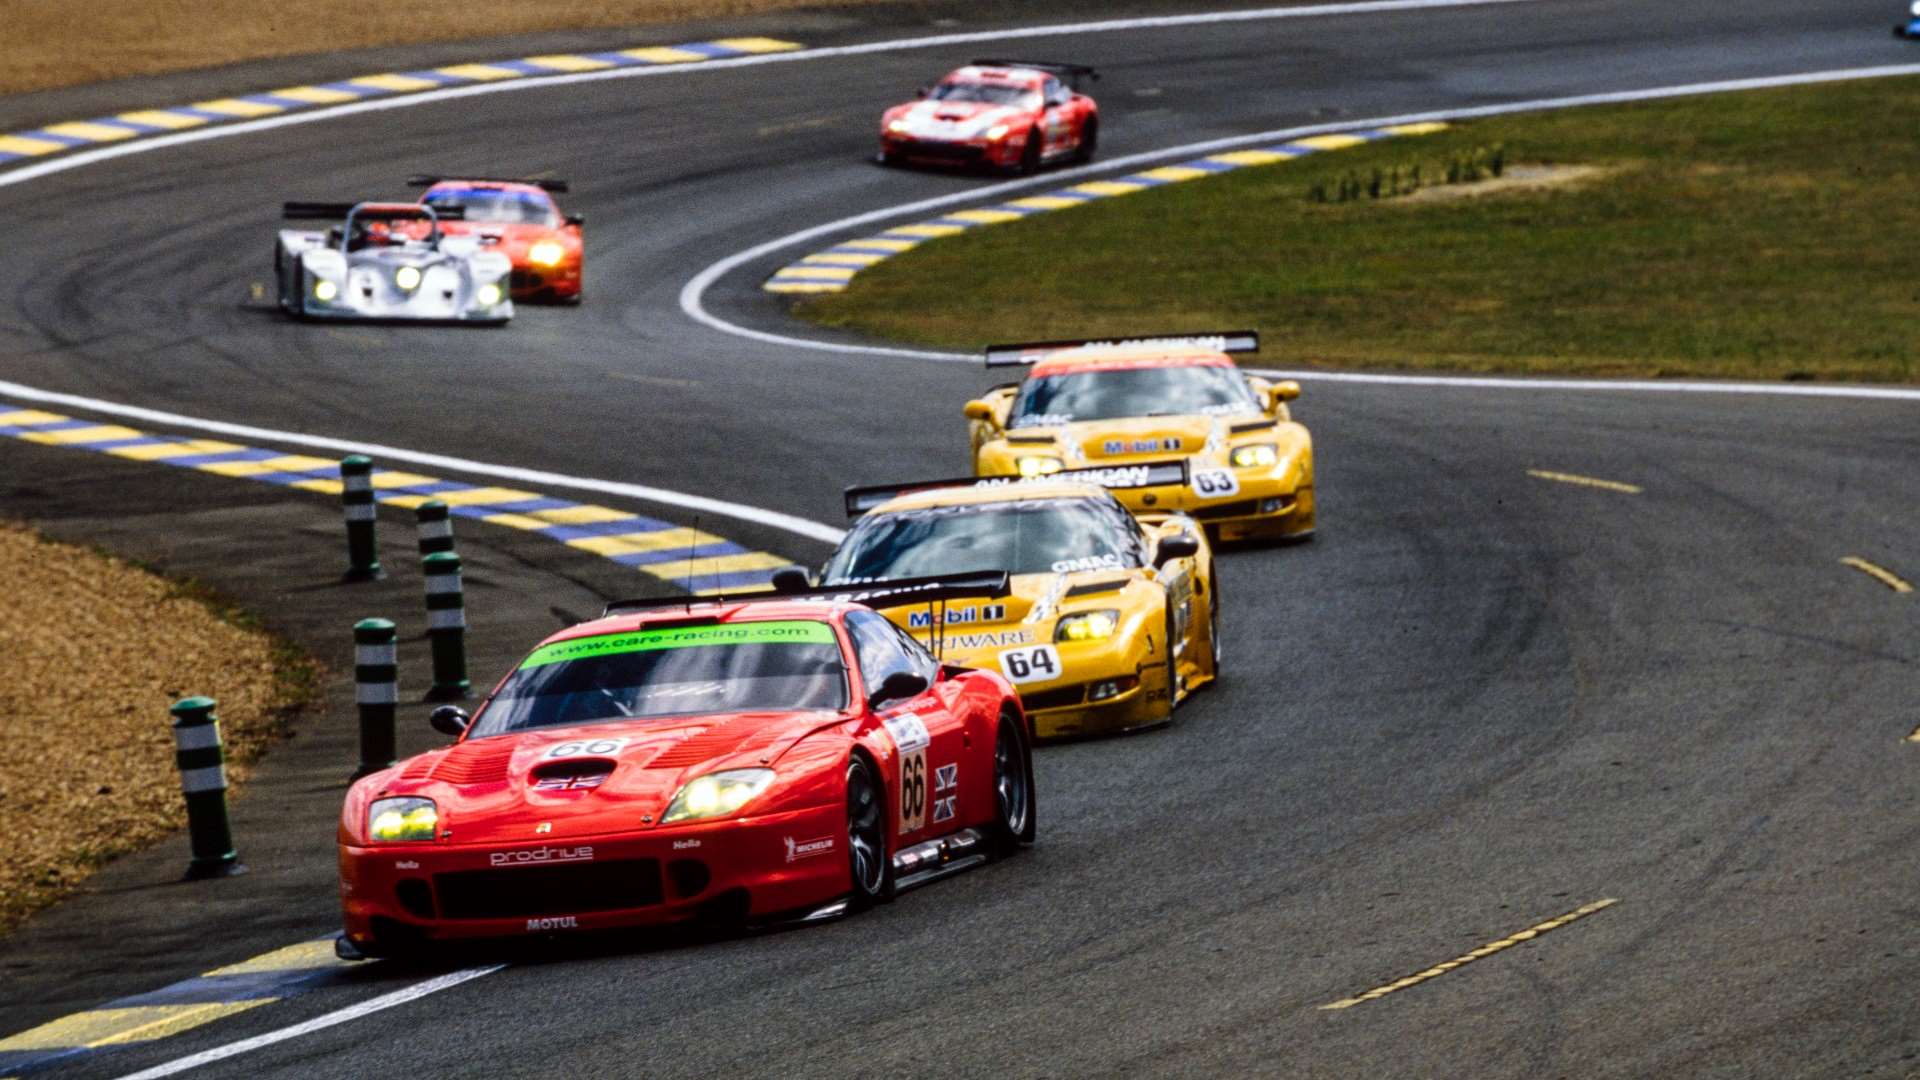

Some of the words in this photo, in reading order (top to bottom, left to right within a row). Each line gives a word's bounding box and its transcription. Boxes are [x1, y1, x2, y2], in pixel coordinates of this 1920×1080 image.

[1104, 440, 1158, 454] Mobil
[1195, 471, 1233, 493] 63
[1051, 553, 1120, 573] GMAC
[909, 607, 976, 628] Mobil
[550, 626, 810, 657] www.care-racing.com
[1005, 648, 1054, 678] 64
[550, 740, 622, 758] 66
[902, 754, 924, 820] 66
[673, 838, 701, 850] Hella
[796, 839, 834, 853] MICHELIN
[489, 846, 594, 867] prodrive
[526, 916, 579, 931] MOTUL
